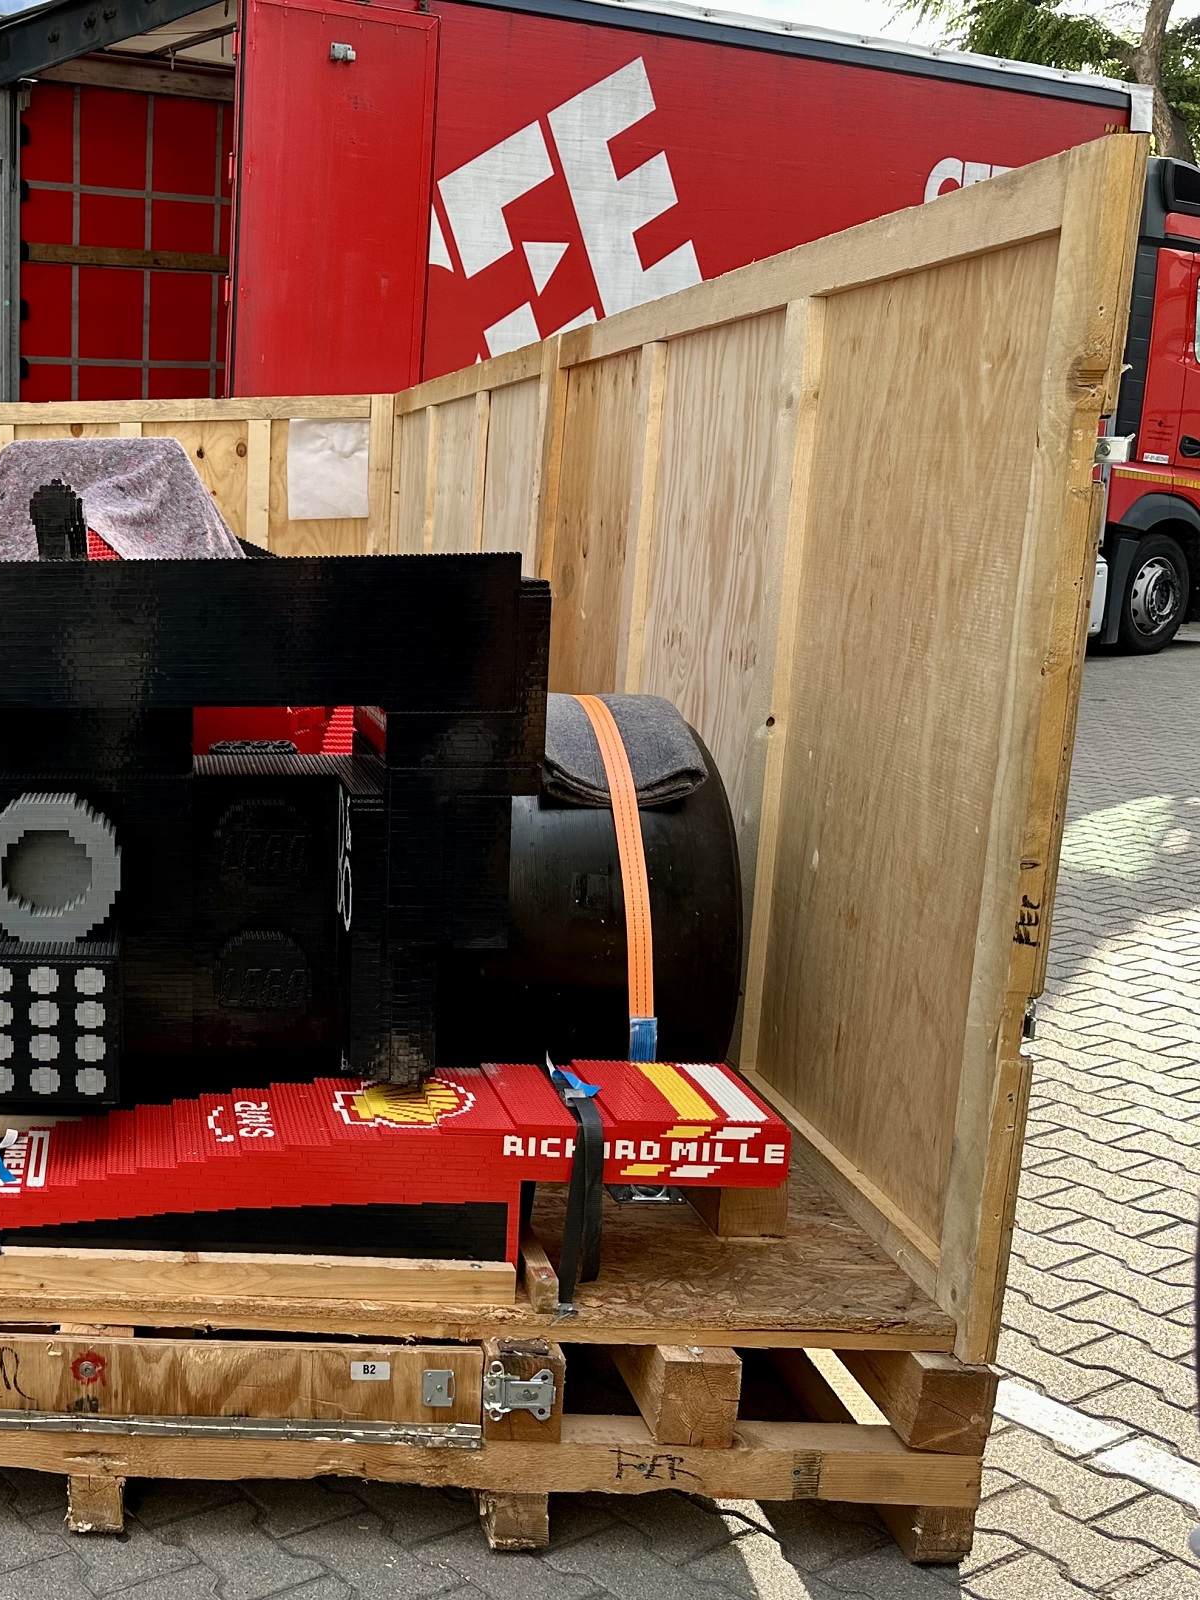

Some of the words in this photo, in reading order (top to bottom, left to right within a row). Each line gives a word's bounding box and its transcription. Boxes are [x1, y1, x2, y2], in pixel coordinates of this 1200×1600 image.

[220, 834, 307, 873] LEGO
[220, 967, 306, 1008] LEGO
[670, 1141, 785, 1164] MILLE
[362, 1364, 376, 1375] B2
